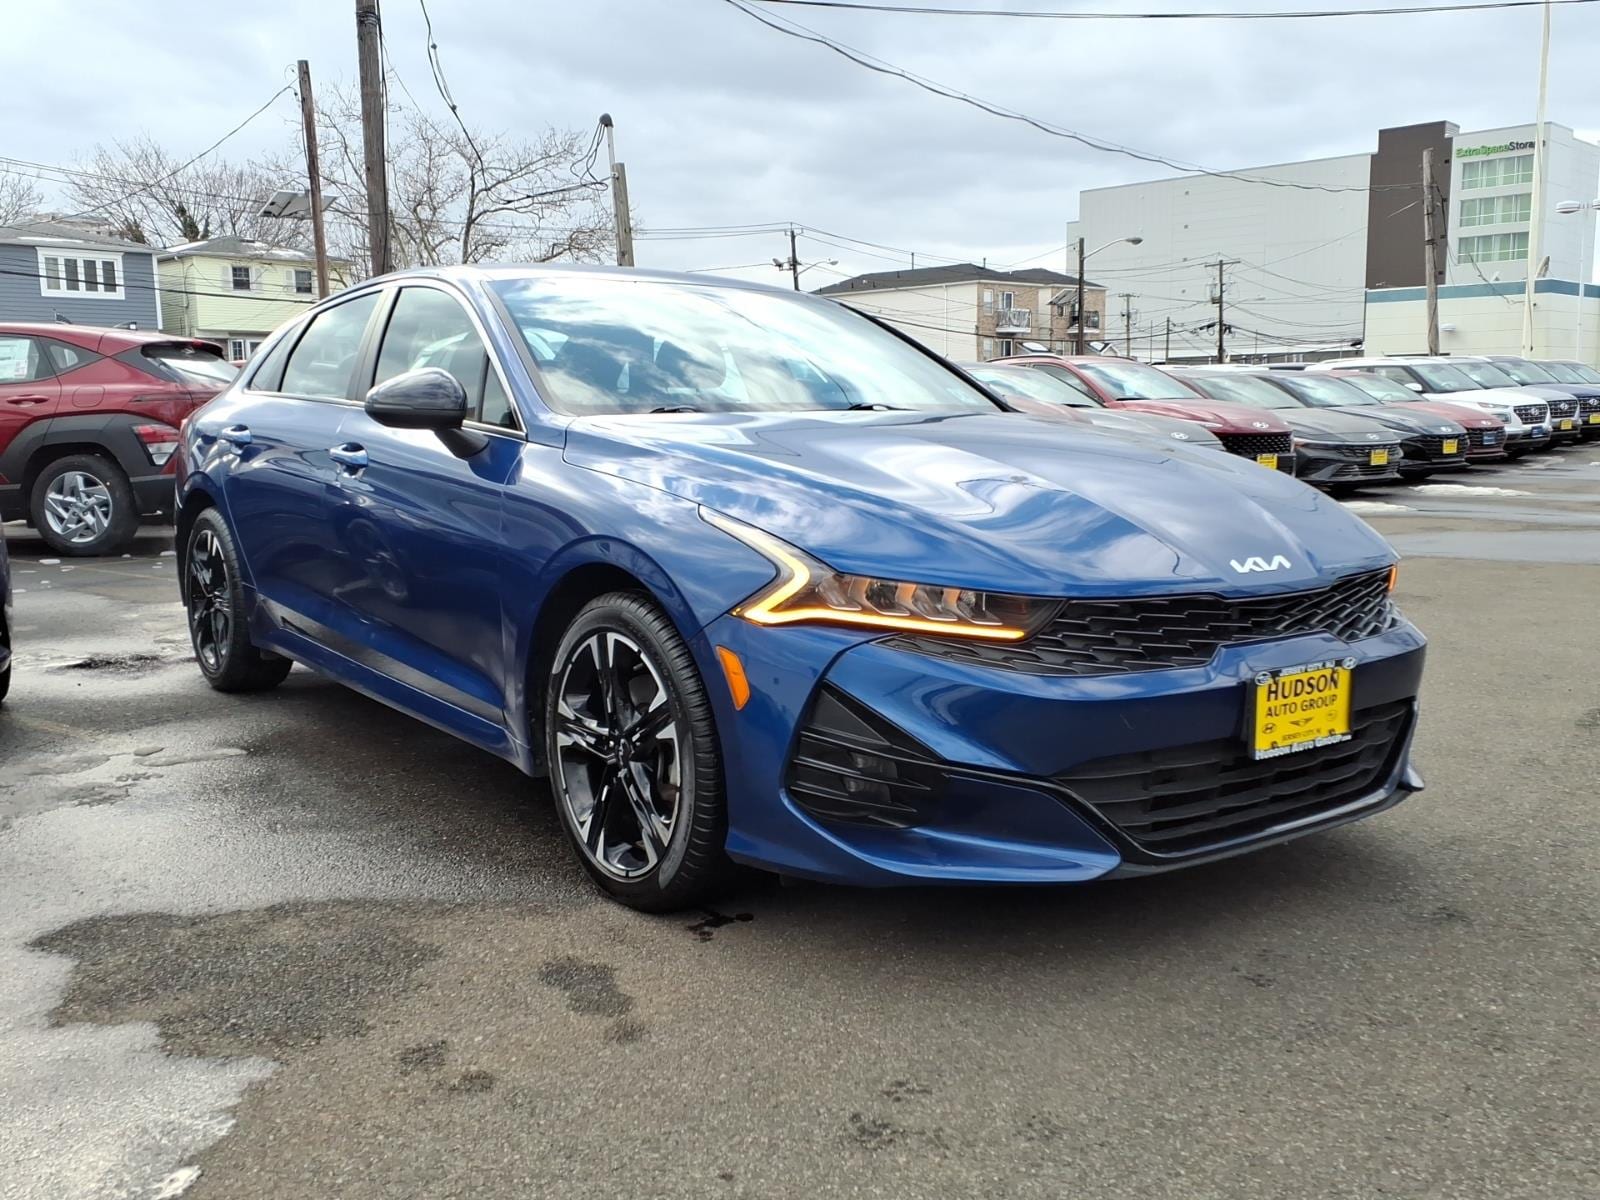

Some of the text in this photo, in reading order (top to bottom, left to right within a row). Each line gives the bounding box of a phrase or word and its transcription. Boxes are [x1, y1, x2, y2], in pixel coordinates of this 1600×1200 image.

[1229, 555, 1292, 574] KIA
[1266, 671, 1339, 702] HUDSON
[1265, 694, 1338, 718] AUTO GROUP
